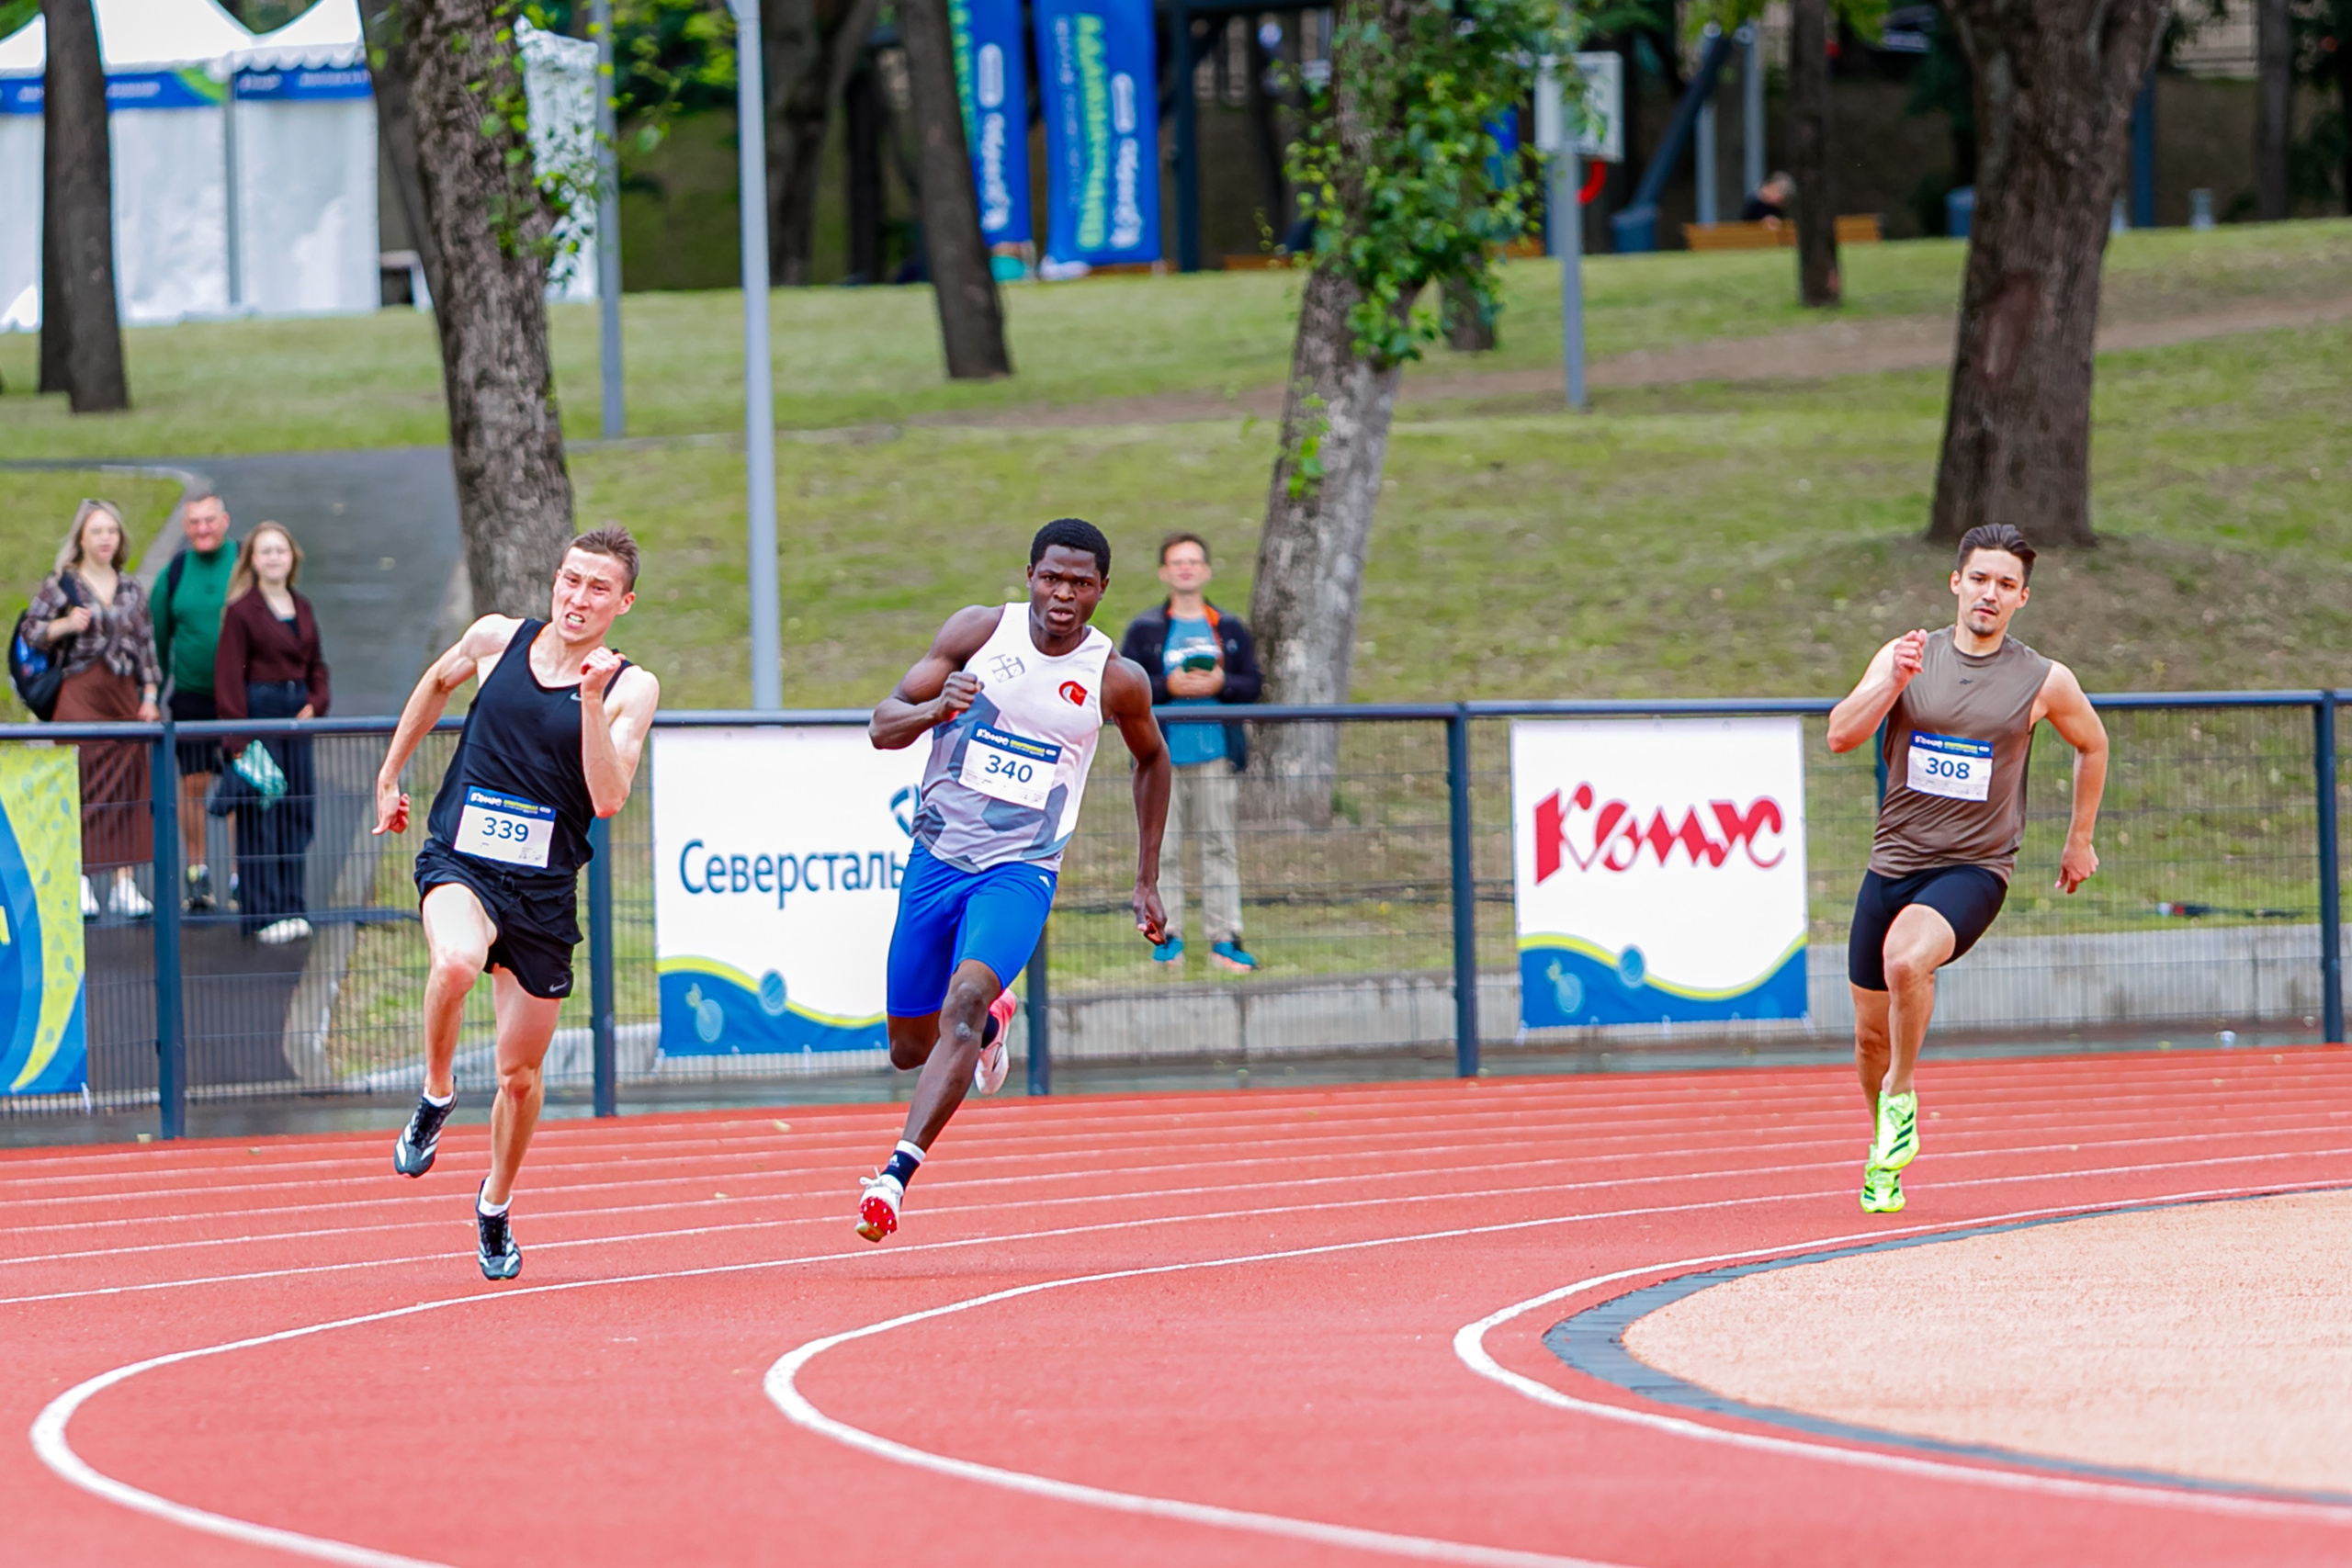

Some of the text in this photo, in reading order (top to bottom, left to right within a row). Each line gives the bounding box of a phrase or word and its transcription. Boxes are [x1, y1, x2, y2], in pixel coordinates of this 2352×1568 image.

[984, 754, 1034, 783] 340
[1925, 757, 1971, 780] 308
[481, 816, 529, 842] 339
[1532, 781, 1786, 886] Комус
[679, 838, 905, 910] Северсталь
